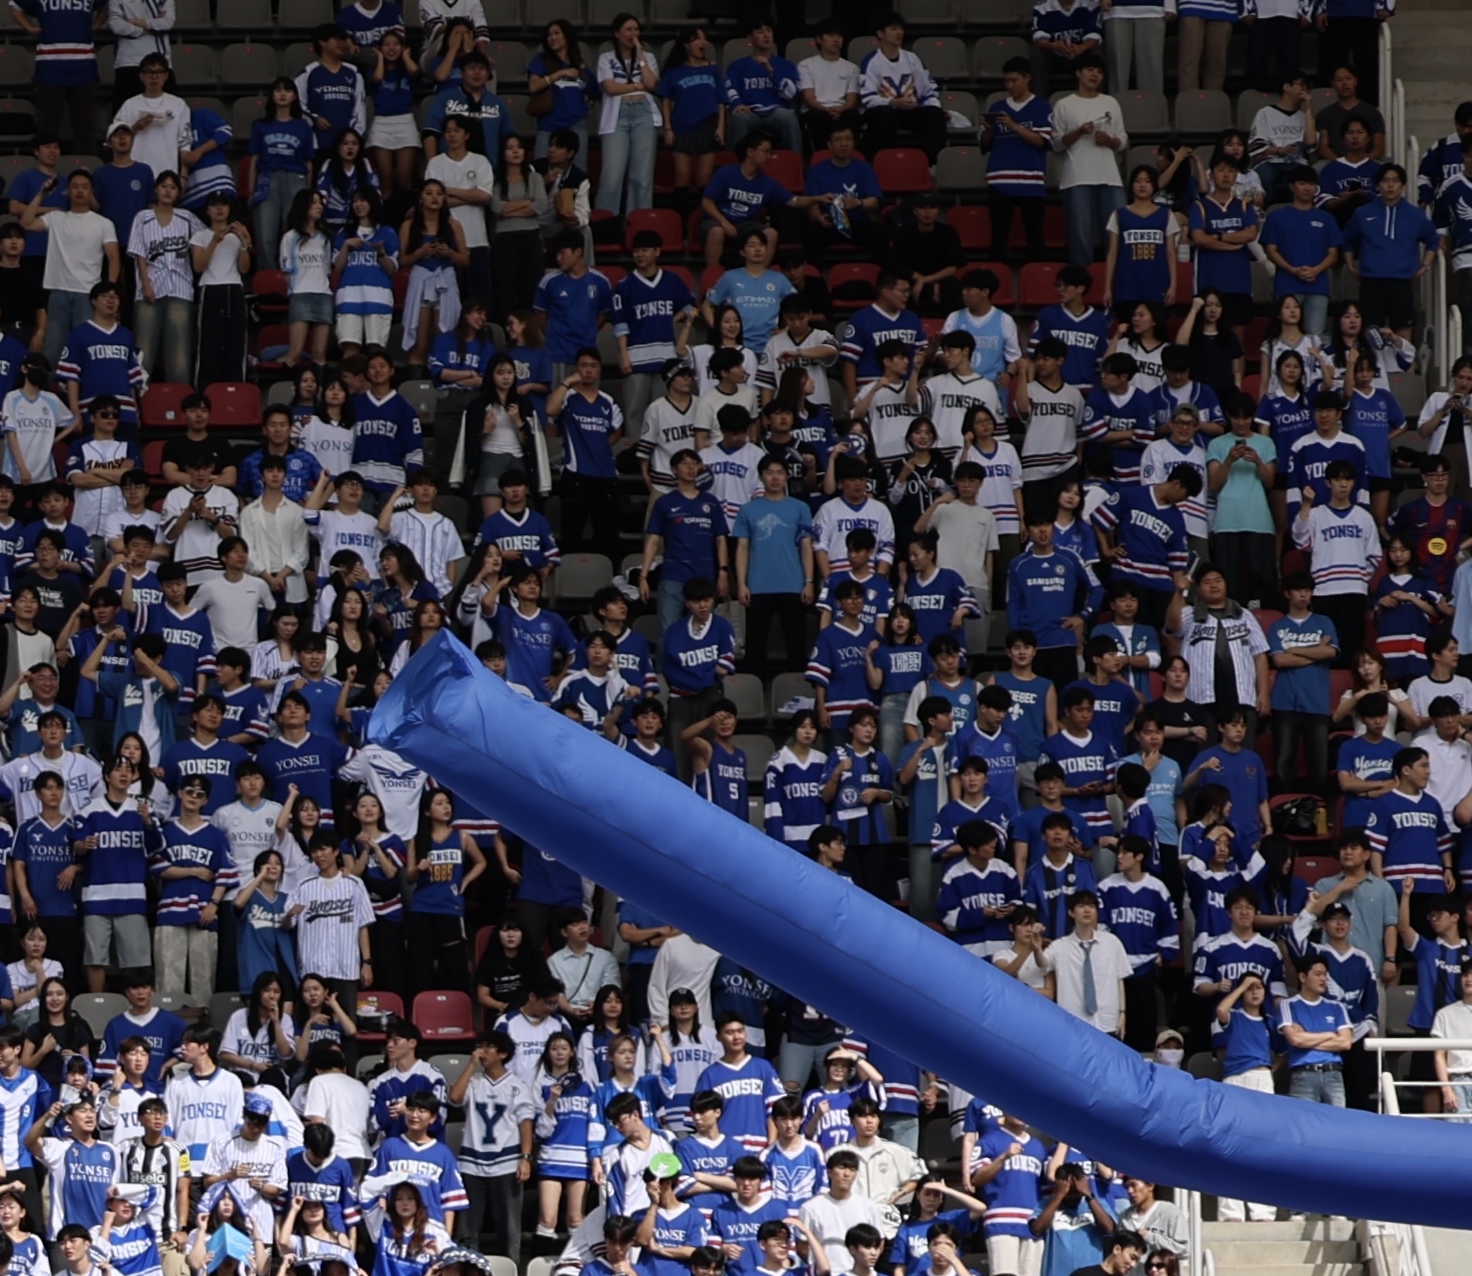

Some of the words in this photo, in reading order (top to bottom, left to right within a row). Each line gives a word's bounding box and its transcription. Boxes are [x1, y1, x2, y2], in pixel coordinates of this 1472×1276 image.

[178, 759, 230, 775] YONSEI
[276, 755, 320, 770] YONSEI
[729, 783, 738, 799] 5
[475, 1102, 504, 1144] Y
